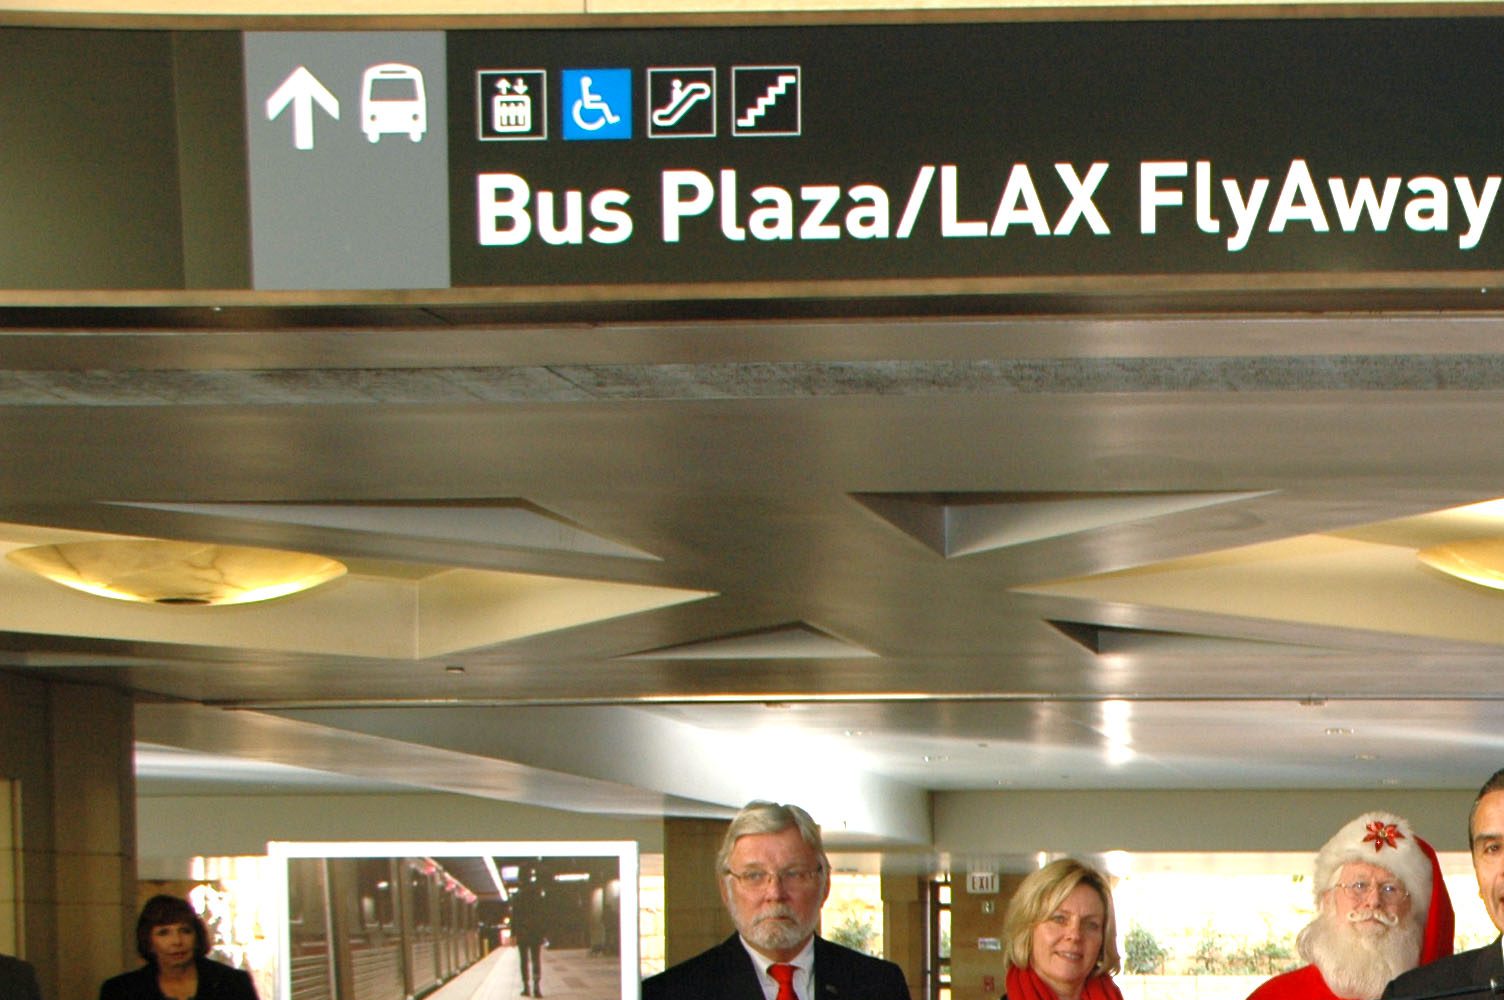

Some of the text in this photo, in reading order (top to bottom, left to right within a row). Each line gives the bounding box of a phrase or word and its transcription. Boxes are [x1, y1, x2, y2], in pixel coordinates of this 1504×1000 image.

[478, 159, 1502, 251] Bus Plaza/LAX FlyAway
[972, 876, 995, 890] EXIT
